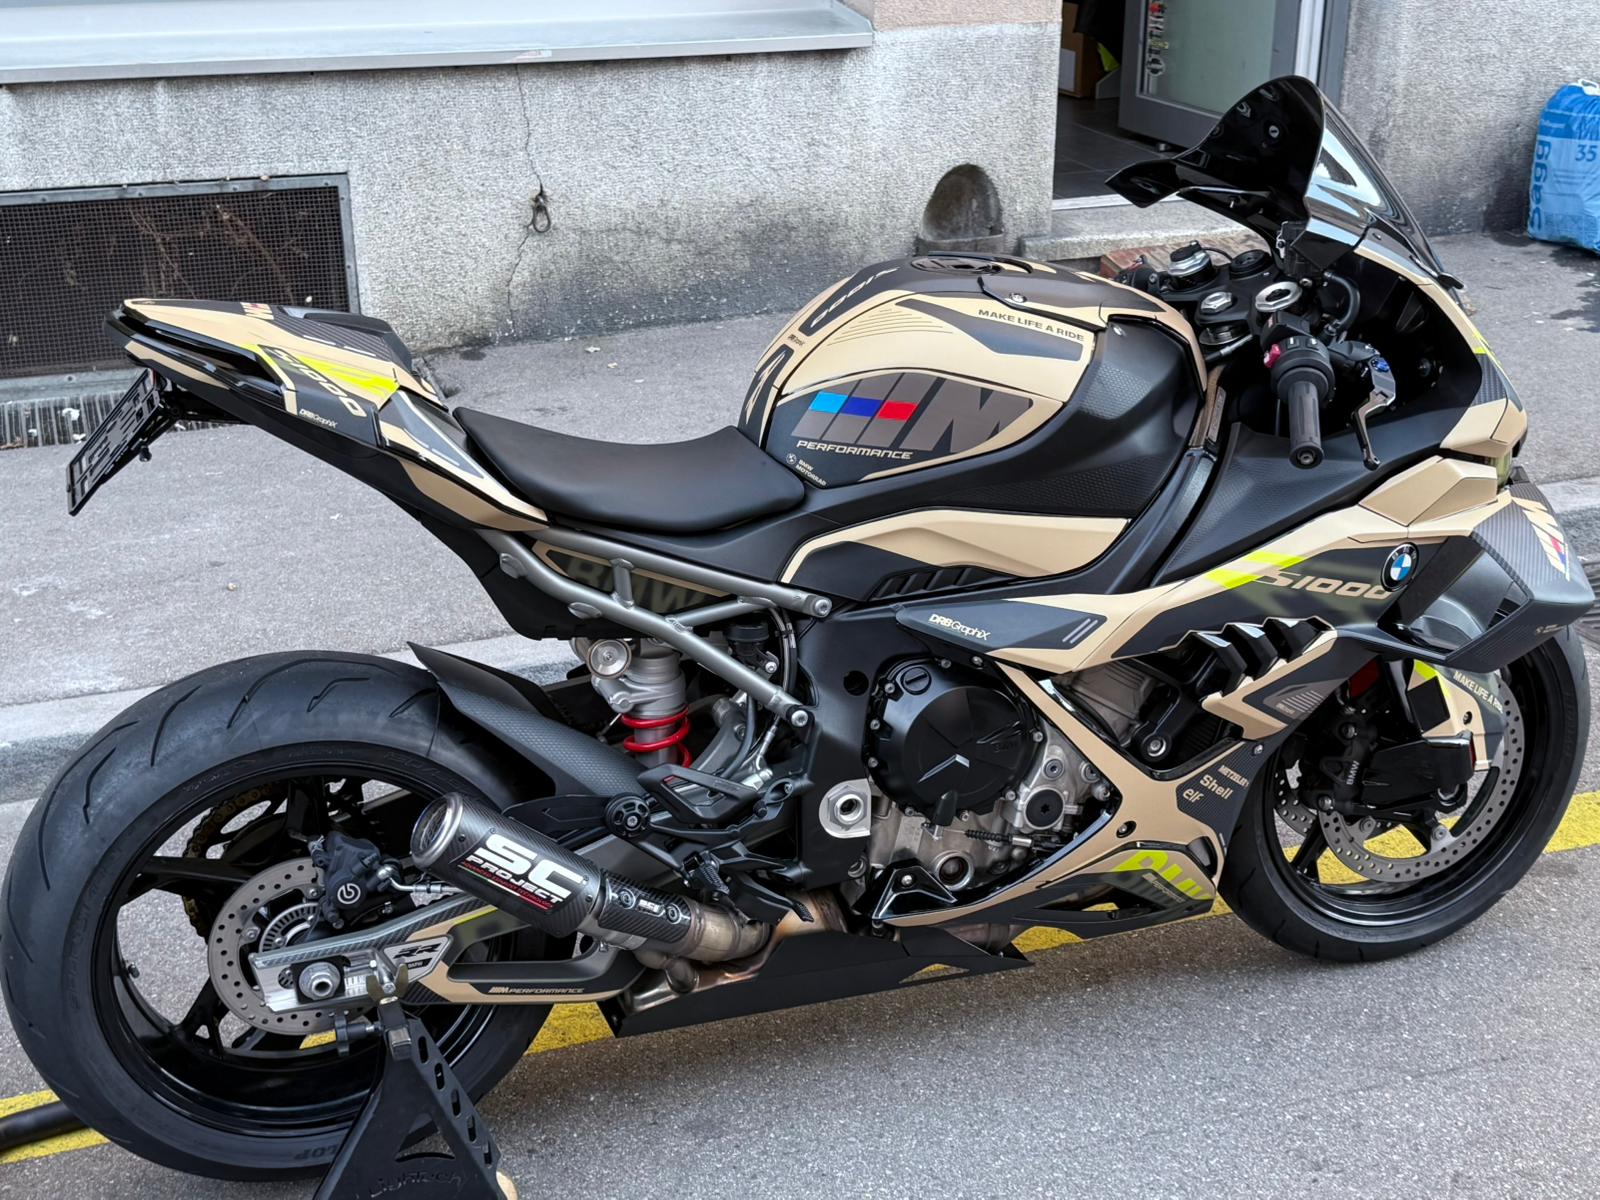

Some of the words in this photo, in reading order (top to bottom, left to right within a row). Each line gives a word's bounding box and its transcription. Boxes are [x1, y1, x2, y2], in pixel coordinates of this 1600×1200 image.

[978, 309, 1015, 325] MAKE
[1017, 317, 1044, 331] LIFE
[1046, 324, 1056, 333] A
[1057, 326, 1085, 341] RIDE
[796, 440, 914, 460] PERFORMANCE
[795, 464, 827, 486] MOTORRAD
[798, 459, 814, 471] BMW
[1453, 670, 1475, 692] MAKE
[1473, 684, 1489, 701] LIFE
[1182, 788, 1204, 803] elf
[1200, 774, 1233, 800] Shell
[465, 855, 563, 904] PROJECT
[475, 834, 584, 900] SC
